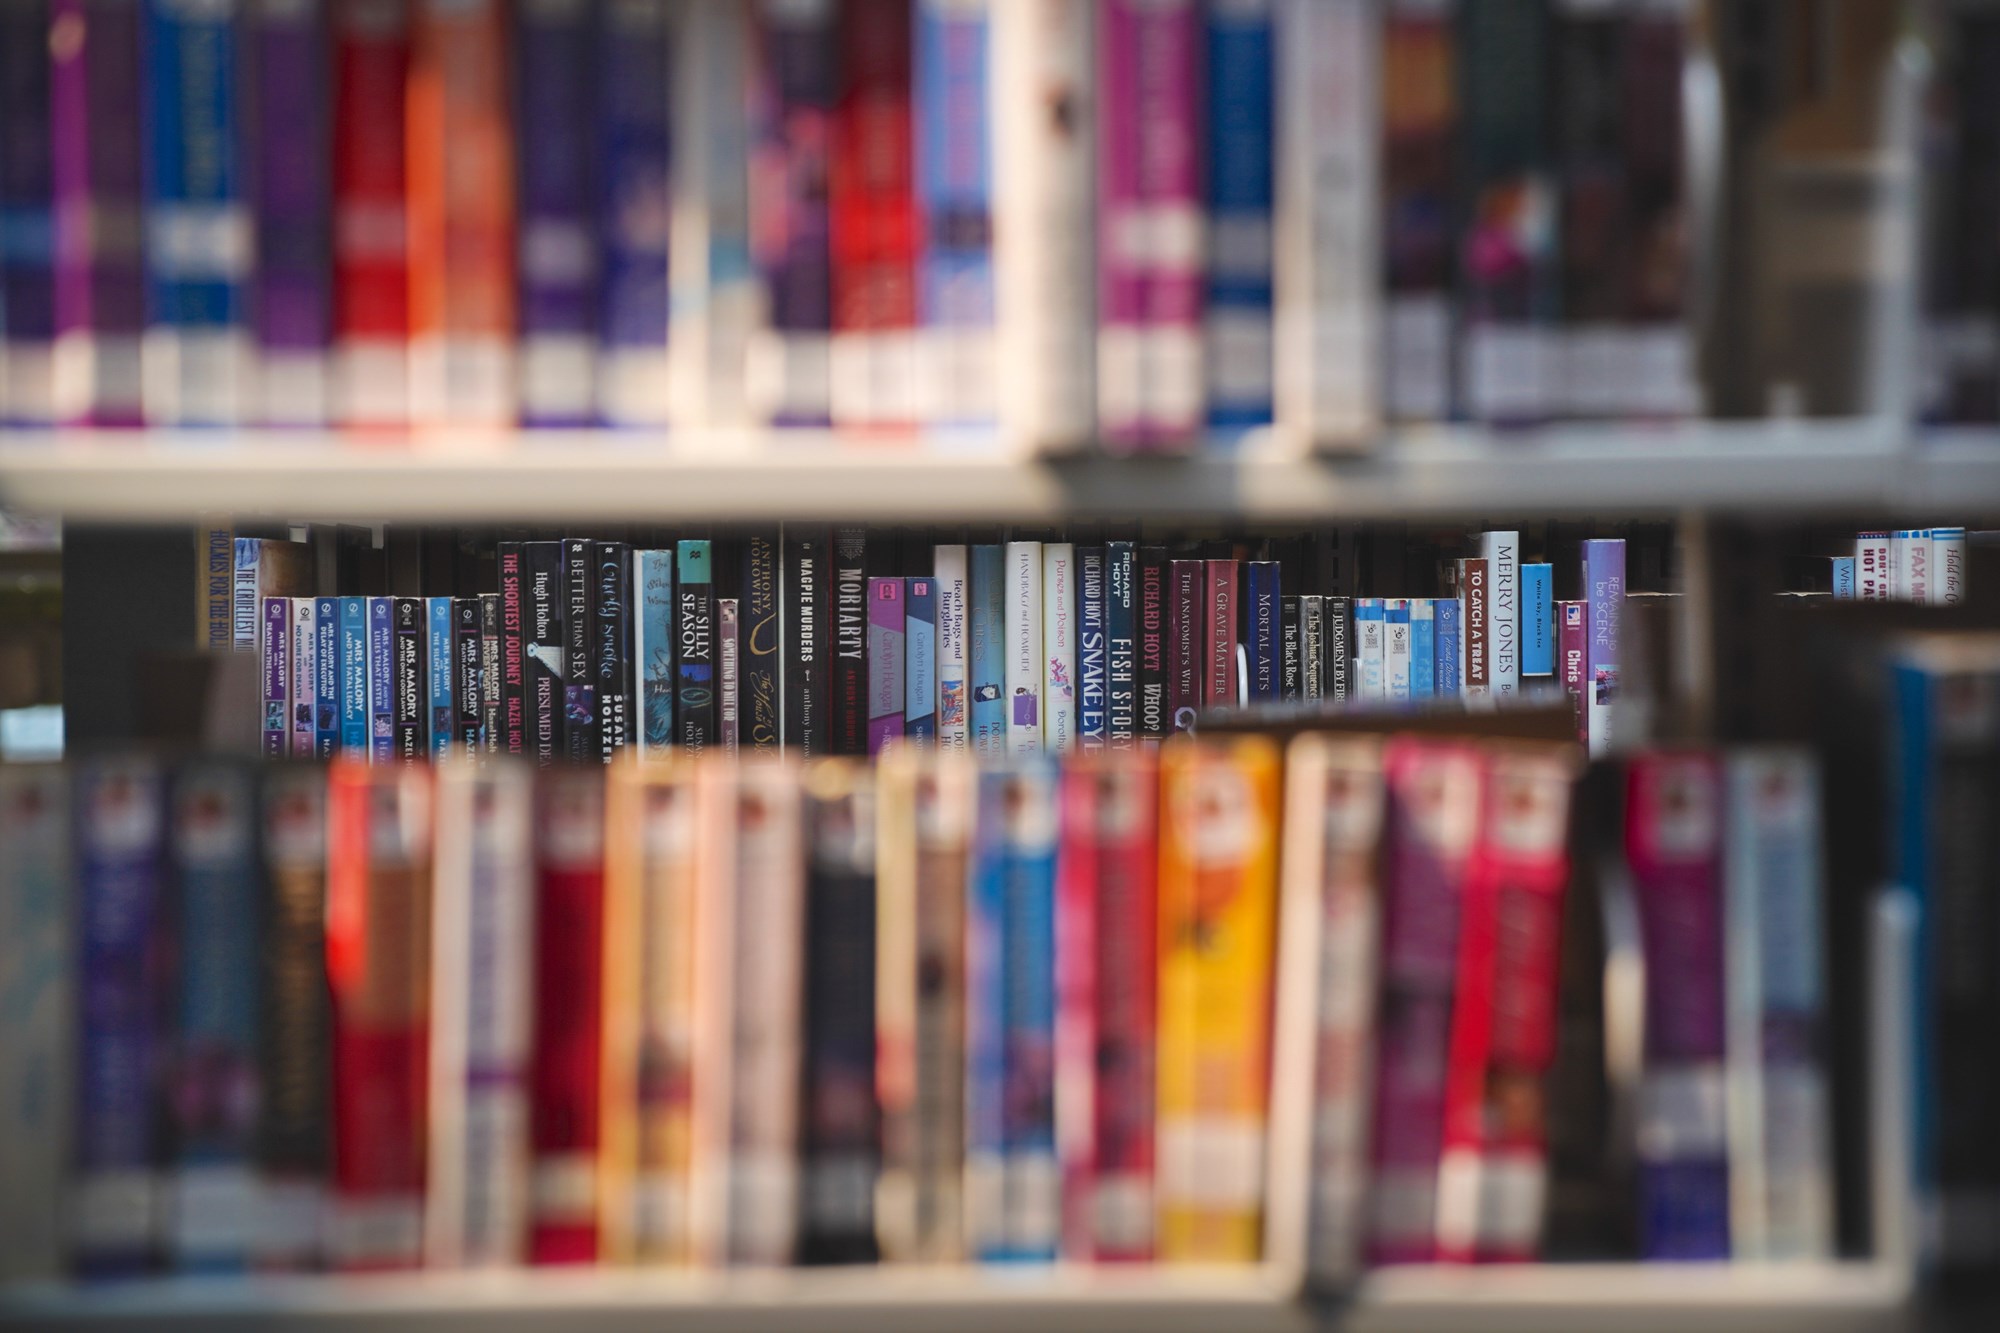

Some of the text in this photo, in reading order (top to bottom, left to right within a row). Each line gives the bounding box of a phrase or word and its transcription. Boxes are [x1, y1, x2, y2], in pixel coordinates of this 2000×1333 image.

[209, 530, 230, 618] HOLMES FOR THE
[751, 536, 762, 616] HOROWITZ
[760, 542, 772, 611] ANTHONY
[1056, 560, 1066, 594] Purses
[1084, 556, 1102, 628] RICHARD HOYT
[1112, 562, 1120, 597] HOYT
[1864, 549, 1875, 574] HOT
[1912, 546, 1926, 579] FAX
[1946, 549, 1961, 592] Hold the
[235, 568, 255, 634] THE CRUELLEST
[296, 625, 302, 636] NO
[504, 553, 521, 686] THE SHORTEST JOURNEY
[532, 572, 550, 639] Hugh Holton
[571, 559, 586, 678] BETTER THAN SEX
[681, 594, 696, 658] SEASON
[696, 597, 710, 660] THE SILLY
[800, 558, 814, 662] MAGPIE MURDERS
[838, 568, 862, 659] MORIARTY
[940, 591, 952, 649] Burglaries
[952, 579, 964, 660] Beach Bags and
[1056, 612, 1066, 648] Poison
[1144, 566, 1160, 671] RICHARD HOYT
[1471, 570, 1483, 680] TO CATCH A TREAT
[1494, 545, 1513, 674] MERRY JONES
[1596, 582, 1608, 646] be SCENE
[1608, 577, 1620, 636] REMAINS
[265, 622, 273, 696] DEATH IN THE FAMILY
[320, 649, 327, 658] OF
[374, 654, 382, 678] THAT
[382, 649, 390, 684] MALORY
[722, 638, 736, 680] SOMETHING
[1020, 624, 1030, 675] HOMICIDE
[1216, 578, 1227, 694] A GRAVE MATTER
[1259, 594, 1270, 690] MORTAL ARTS
[1284, 624, 1298, 687] The Black Rose
[1307, 614, 1320, 698] The Joshua Sequence
[1333, 614, 1344, 682] JUDGMENT BY
[1567, 650, 1581, 683] Chris
[327, 670, 335, 685] AND
[354, 666, 364, 712] MALORY
[406, 639, 416, 718] MRS. MALORY
[466, 638, 477, 716] MRS. MALORY
[484, 640, 492, 701] INVESTIGATES
[490, 663, 500, 700] MALORY
[723, 682, 736, 690] TO
[879, 632, 896, 712] Carolyn Hougan
[914, 632, 926, 704] Carolyn Hougan
[1082, 632, 1104, 706] SNAKE
[1182, 668, 1191, 694] WIFE
[488, 708, 498, 754] Hazel Holt
[508, 697, 522, 754] HAZEL HOLT
[538, 676, 552, 741] PRESUMED
[602, 694, 612, 764] HOLTZER
[614, 694, 623, 746] SUSAN
[723, 707, 736, 721] FOR
[802, 688, 812, 727] anthony
[1056, 710, 1066, 750] Dorothy
[1144, 683, 1161, 731] WHOO?
[405, 728, 413, 757] HAZEL
